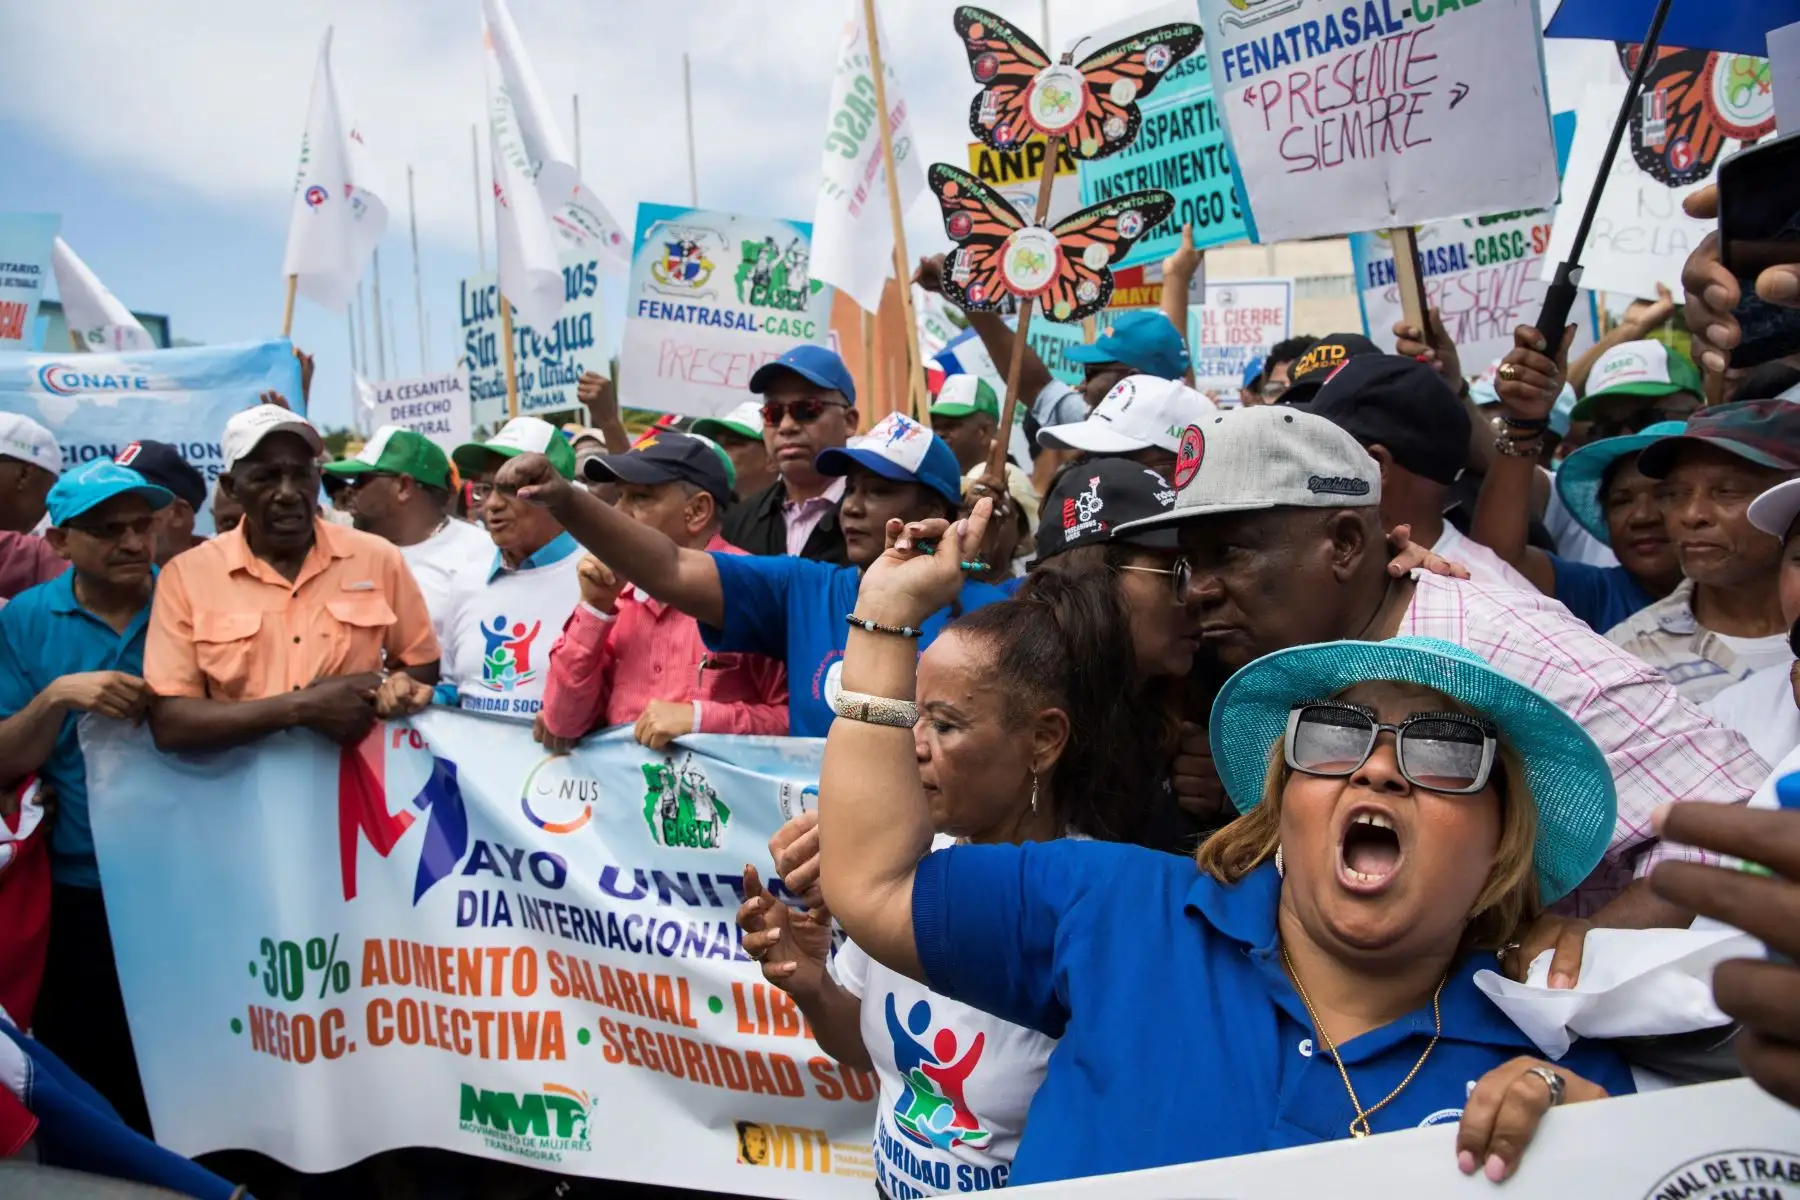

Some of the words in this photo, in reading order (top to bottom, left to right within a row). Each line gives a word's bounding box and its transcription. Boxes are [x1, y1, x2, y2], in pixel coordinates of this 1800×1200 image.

[1222, 0, 1484, 83] FENATRASAL-C
[1165, 55, 1208, 84] ASC
[1119, 98, 1222, 159] ISPARTI
[1279, 91, 1433, 174] SIEMPRE
[1138, 190, 1225, 243] ALOGO
[751, 284, 805, 312] CASC
[1224, 307, 1283, 326] CIERRE
[637, 299, 816, 339] FENATRASAL-CASC
[465, 327, 498, 371] Sin
[391, 399, 451, 420] DERECHO
[664, 821, 712, 849] CASC
[456, 889, 513, 929] DIA
[516, 892, 753, 963] INTERNACIONAL
[360, 937, 539, 998] AUMENTO
[546, 948, 699, 1031] SALARIAL
[730, 980, 816, 1041] LIB
[248, 1003, 357, 1066] NEGOC.
[365, 996, 567, 1063] COLECTIVA
[597, 1015, 806, 1099] SEGURIDAD
[806, 1056, 879, 1104] SO
[538, 1138, 593, 1152] MUJERES
[956, 1163, 1013, 1193] SOC
[1703, 1159, 1737, 1184] DE
